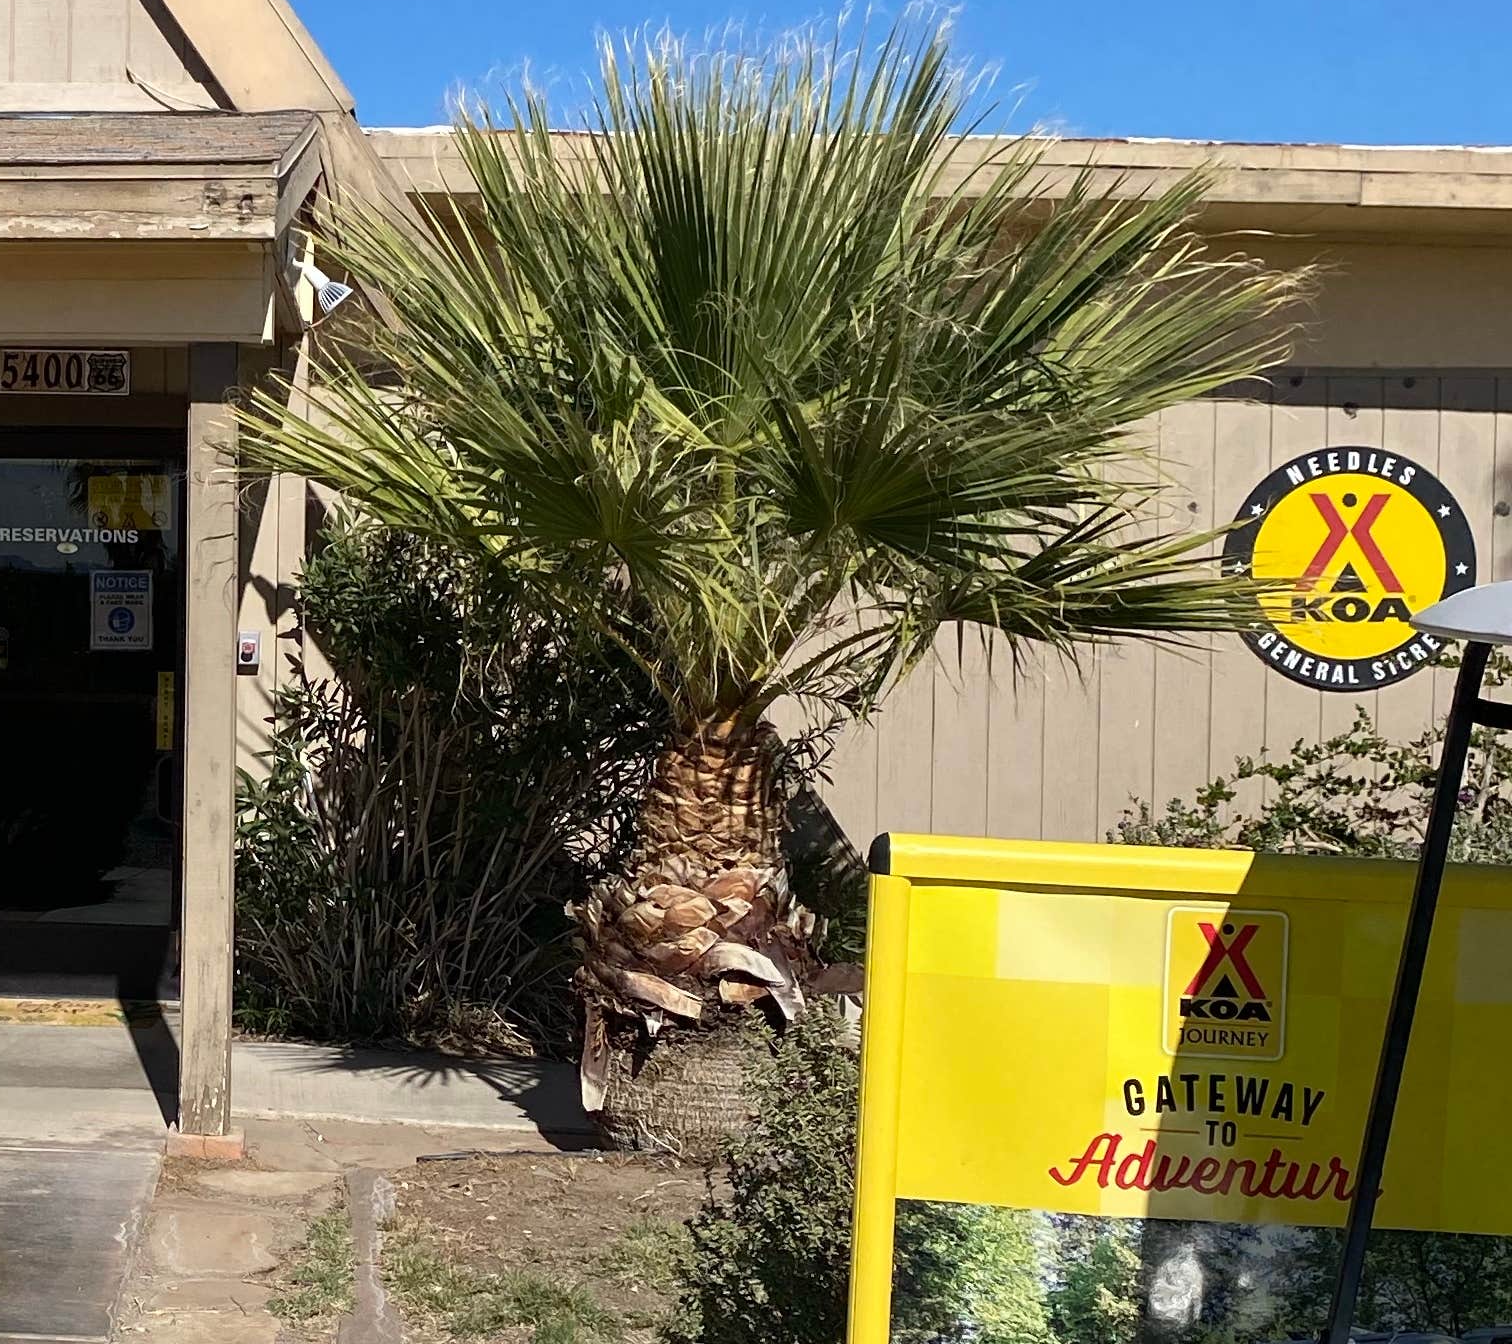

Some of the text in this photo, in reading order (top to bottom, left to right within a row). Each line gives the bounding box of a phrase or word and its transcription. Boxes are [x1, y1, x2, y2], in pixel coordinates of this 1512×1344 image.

[0, 353, 83, 389] 5400
[1286, 451, 1417, 485] NEEDLES
[0, 527, 139, 544] RESERVATIONS
[96, 576, 148, 589] NOTICE
[1291, 596, 1412, 623] KOA
[1257, 632, 1441, 685] GENERAL STORE
[1179, 997, 1273, 1022] KOA
[1178, 1027, 1269, 1048] JOURNEY
[1123, 1073, 1326, 1127] GATEWAY
[1206, 1120, 1237, 1147] TO
[1048, 1132, 1384, 1201] Adventur
